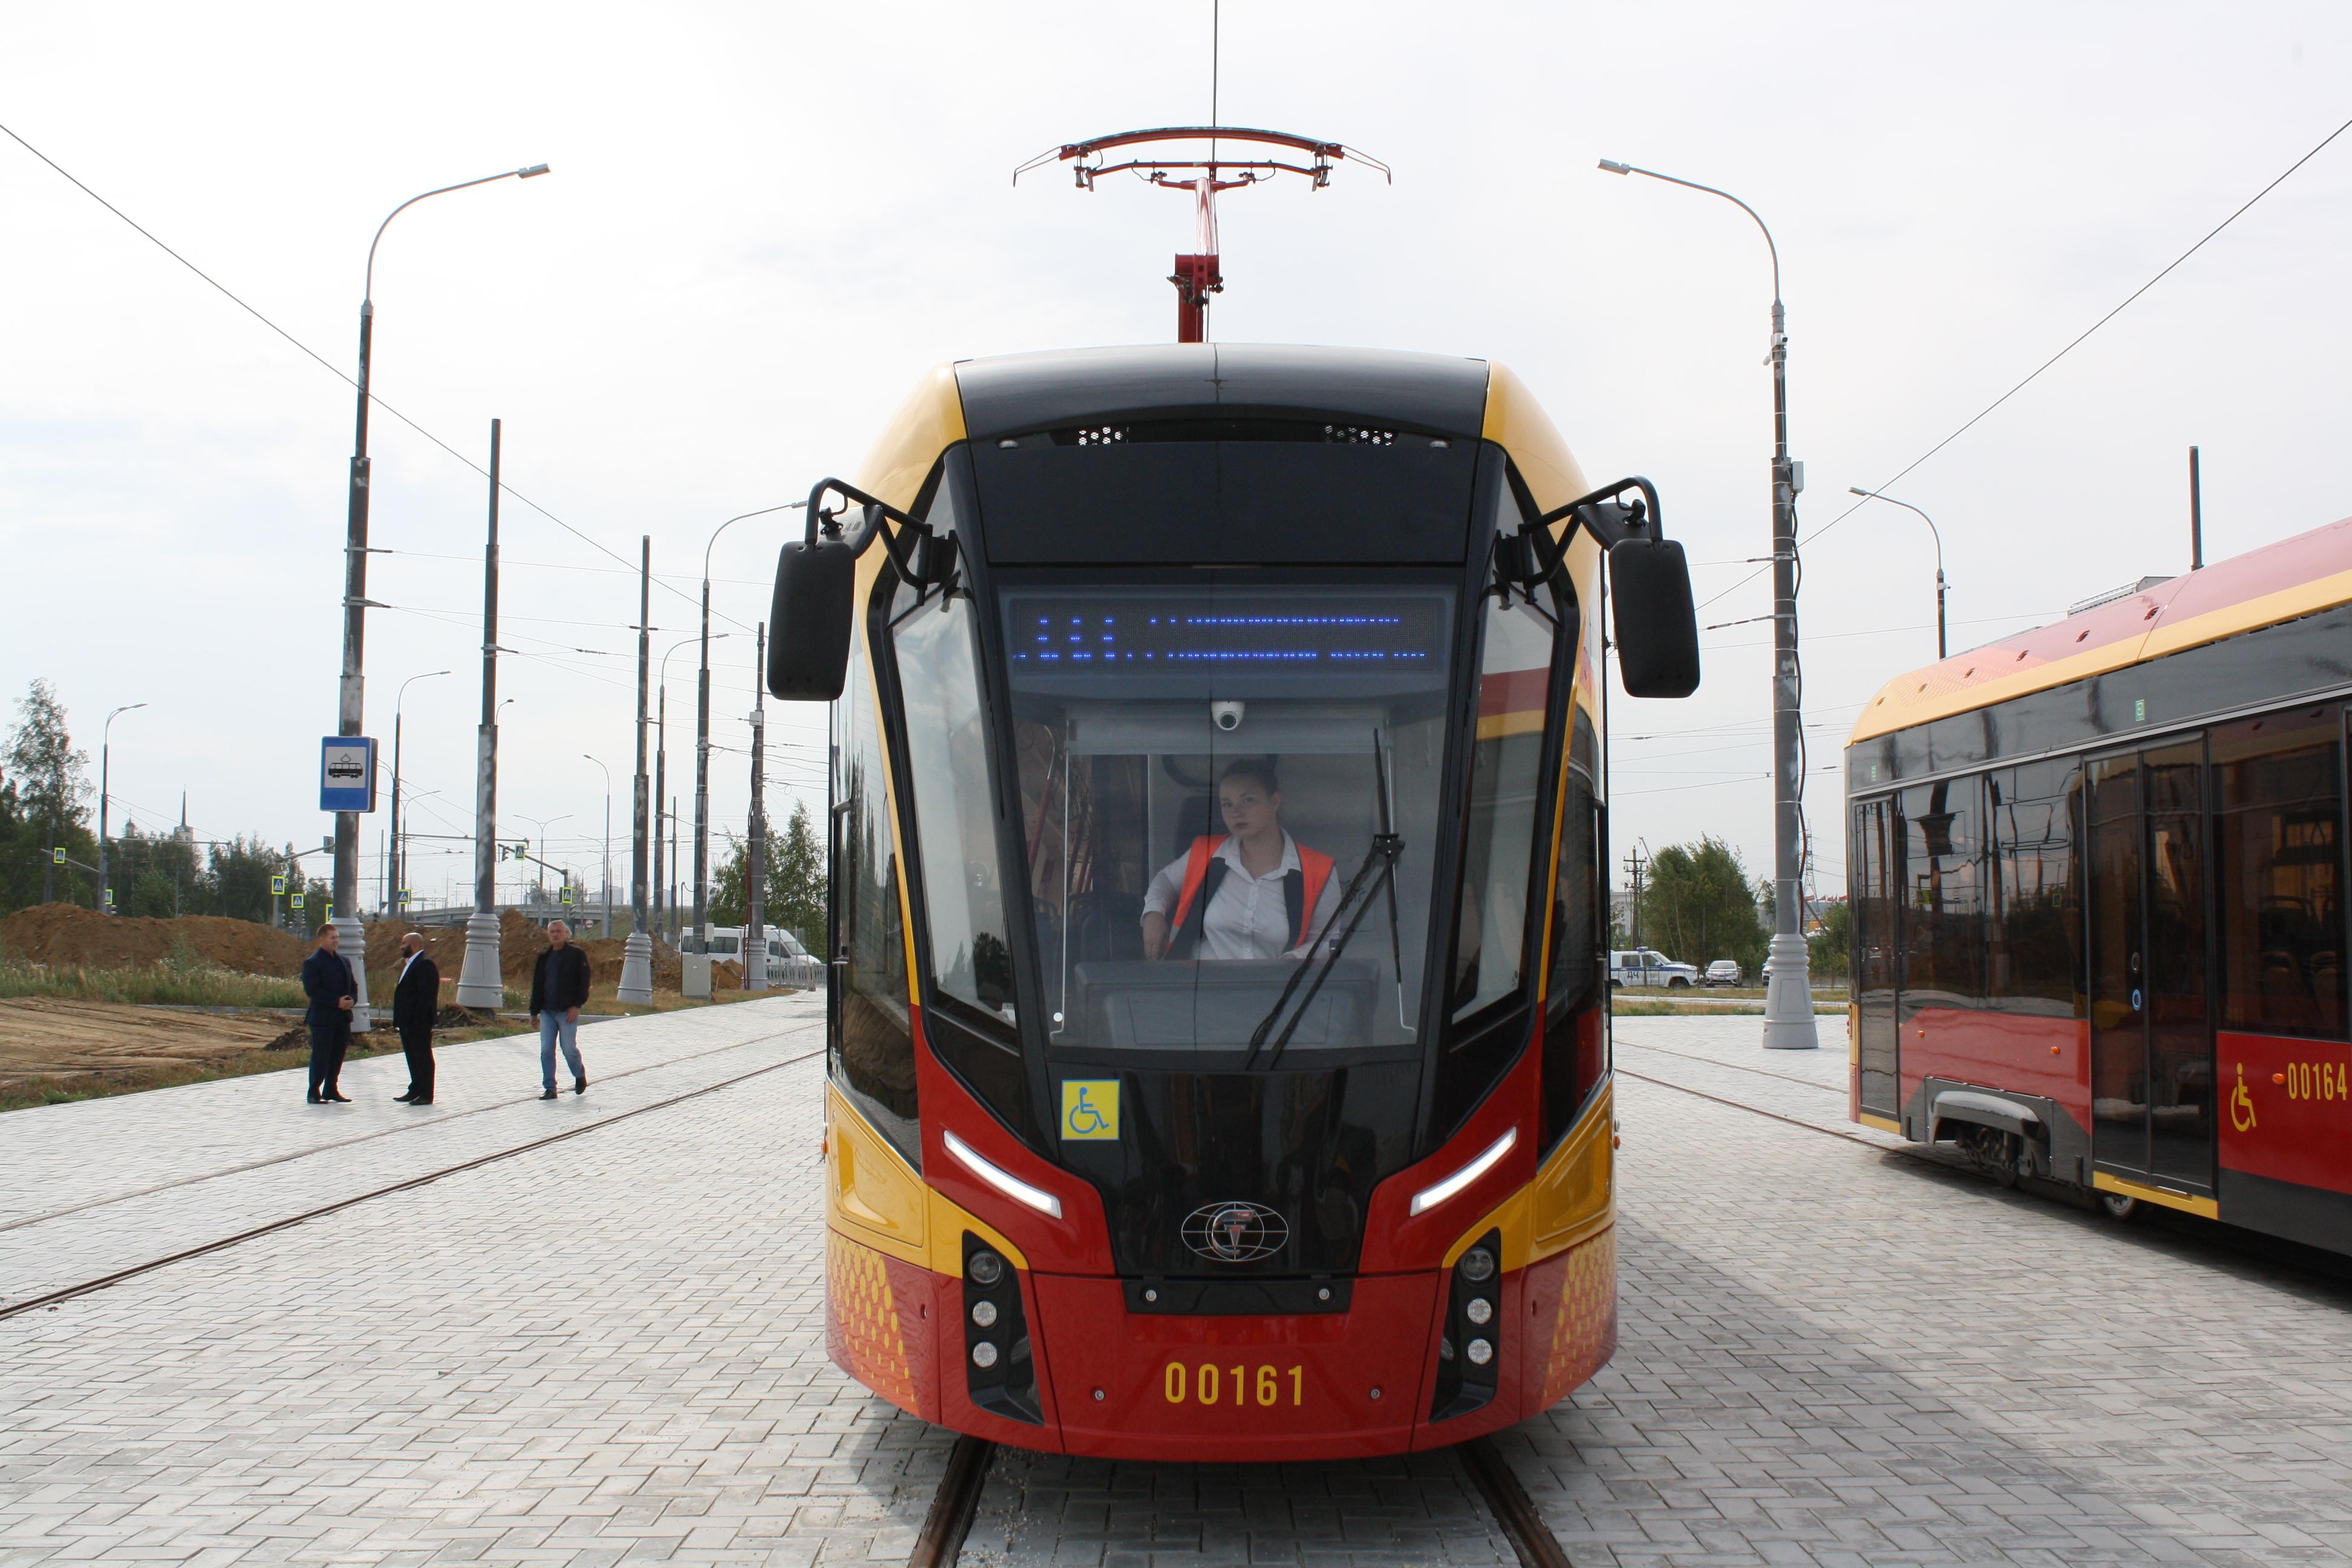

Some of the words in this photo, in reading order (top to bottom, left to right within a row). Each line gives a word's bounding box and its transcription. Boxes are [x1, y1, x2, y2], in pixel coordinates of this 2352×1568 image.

[1627, 970, 1639, 979] ДЧ
[2288, 1062, 2347, 1100] 00164
[1165, 1362, 1302, 1406] 00161
